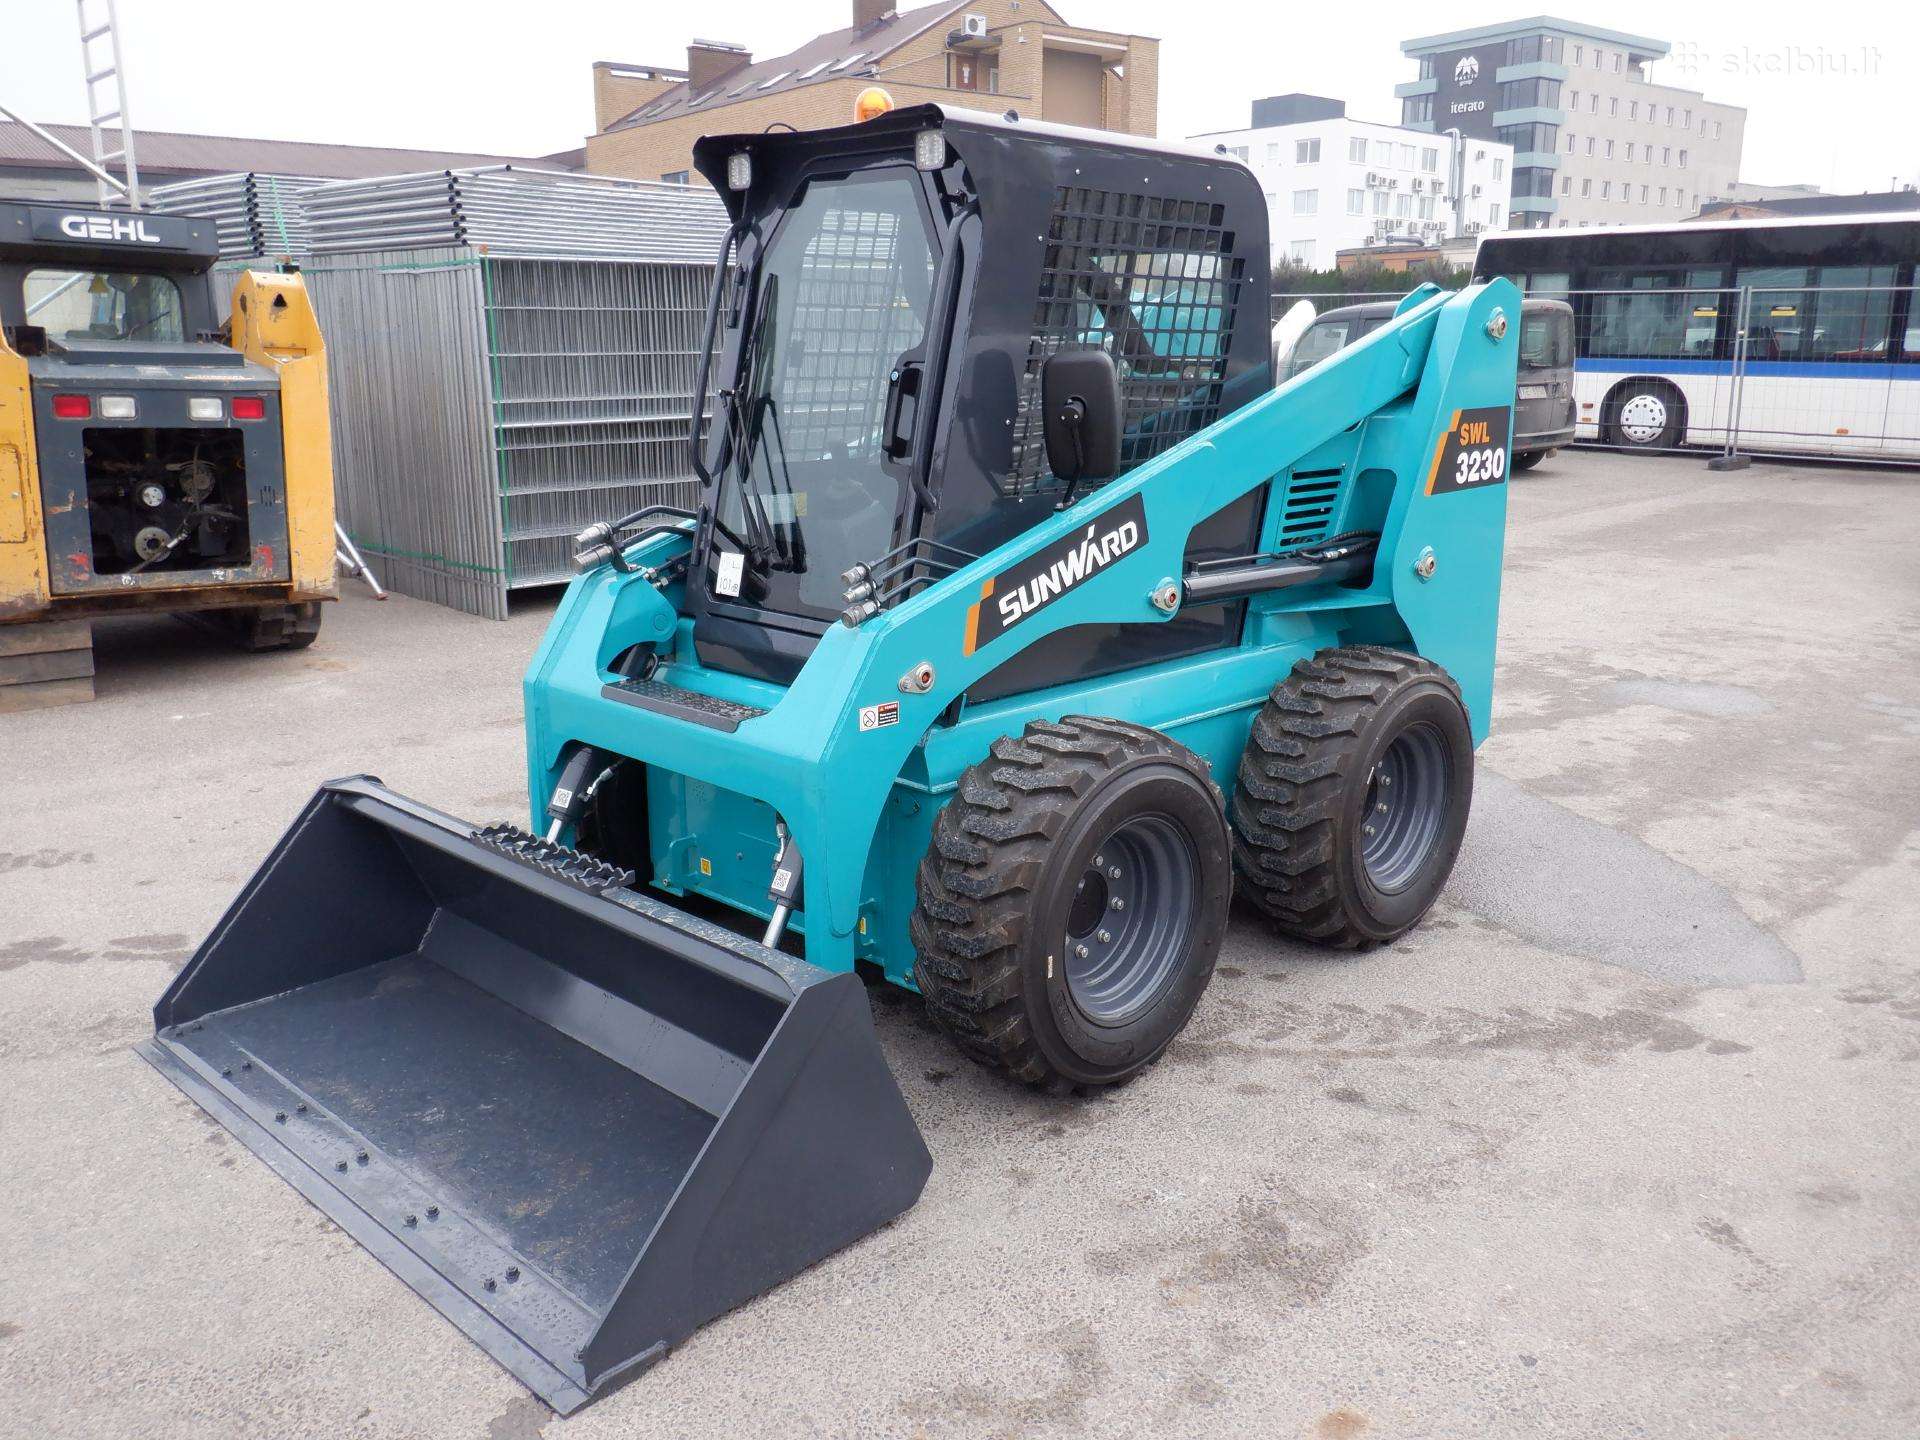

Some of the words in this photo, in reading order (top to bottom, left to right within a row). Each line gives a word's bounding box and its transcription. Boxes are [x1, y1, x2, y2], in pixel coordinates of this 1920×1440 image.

[1450, 100, 1485, 114] iterato
[61, 215, 160, 243] GEHL
[1459, 421, 1490, 446] SWL
[1455, 447, 1505, 485] 3230
[998, 520, 1138, 627] SUNWARD
